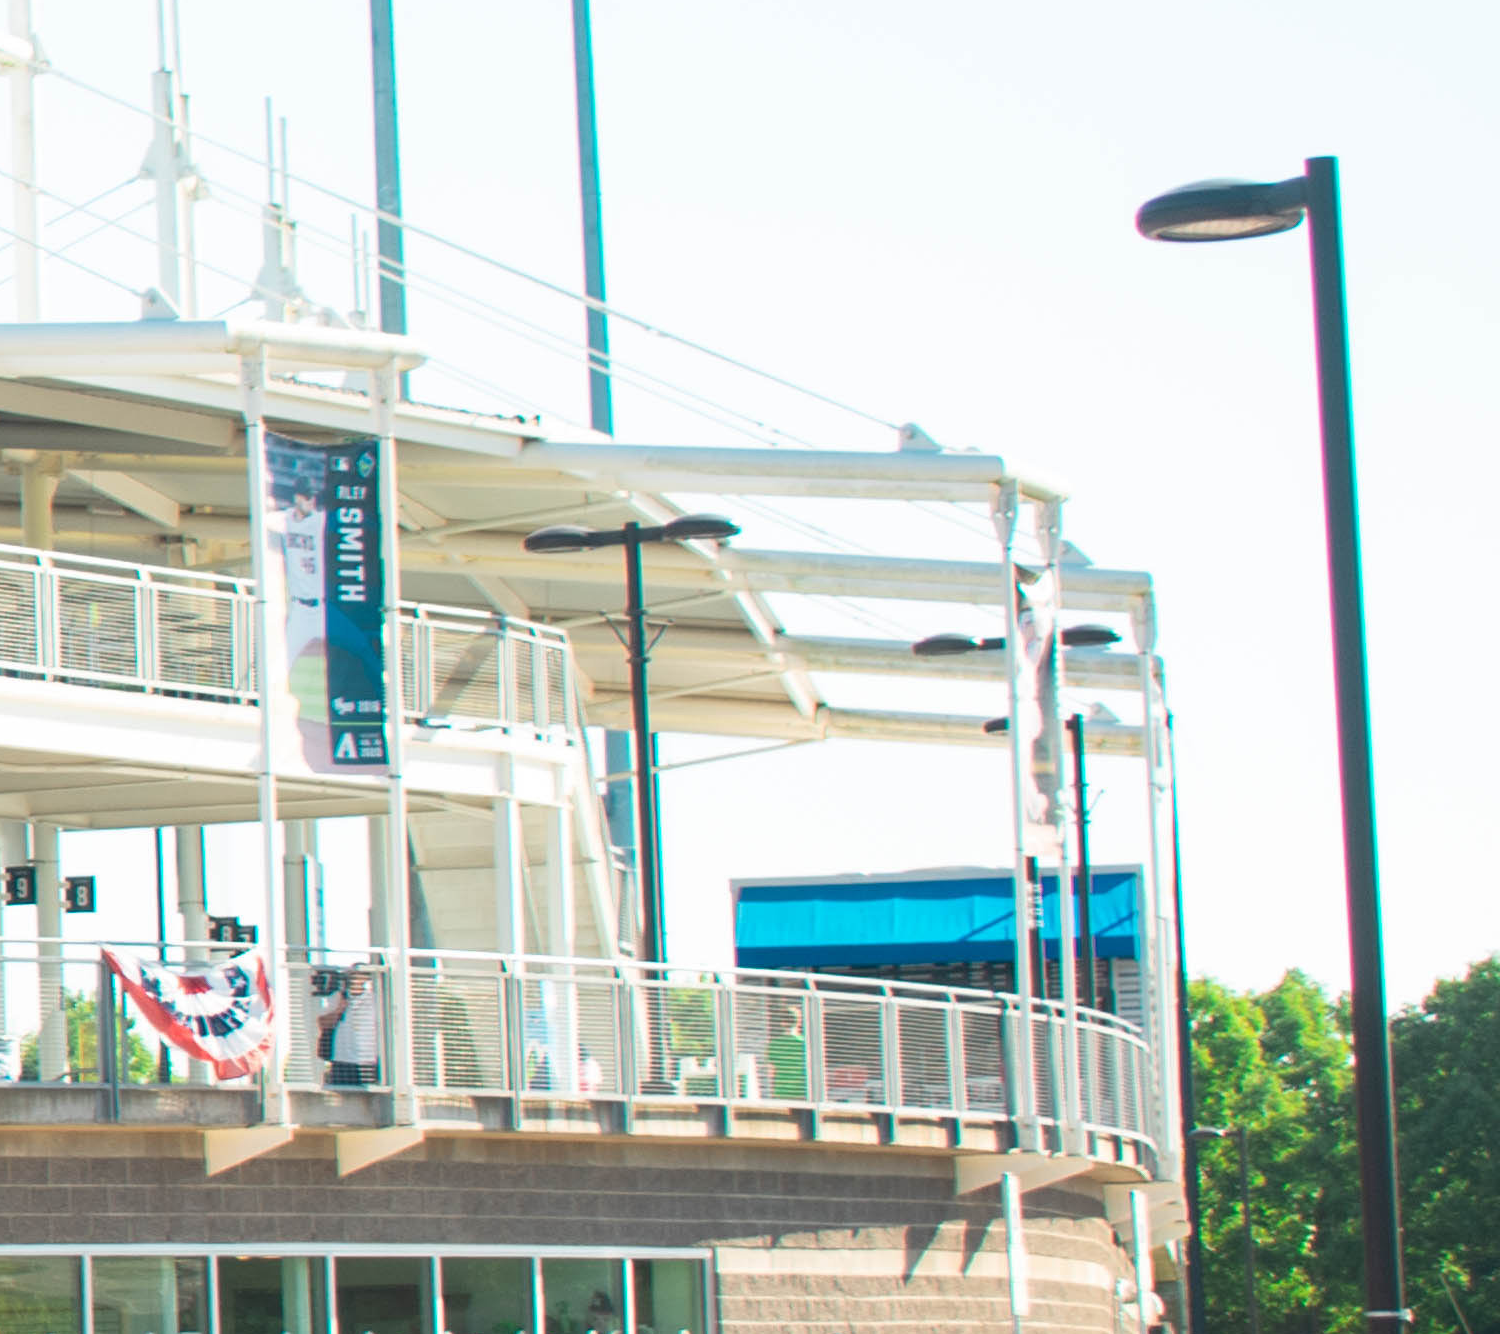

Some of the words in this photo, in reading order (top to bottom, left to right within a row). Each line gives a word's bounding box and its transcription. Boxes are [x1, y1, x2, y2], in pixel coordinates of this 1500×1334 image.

[337, 507, 368, 602] SMITH
[14, 876, 28, 899] 9
[76, 885, 90, 907] 8
